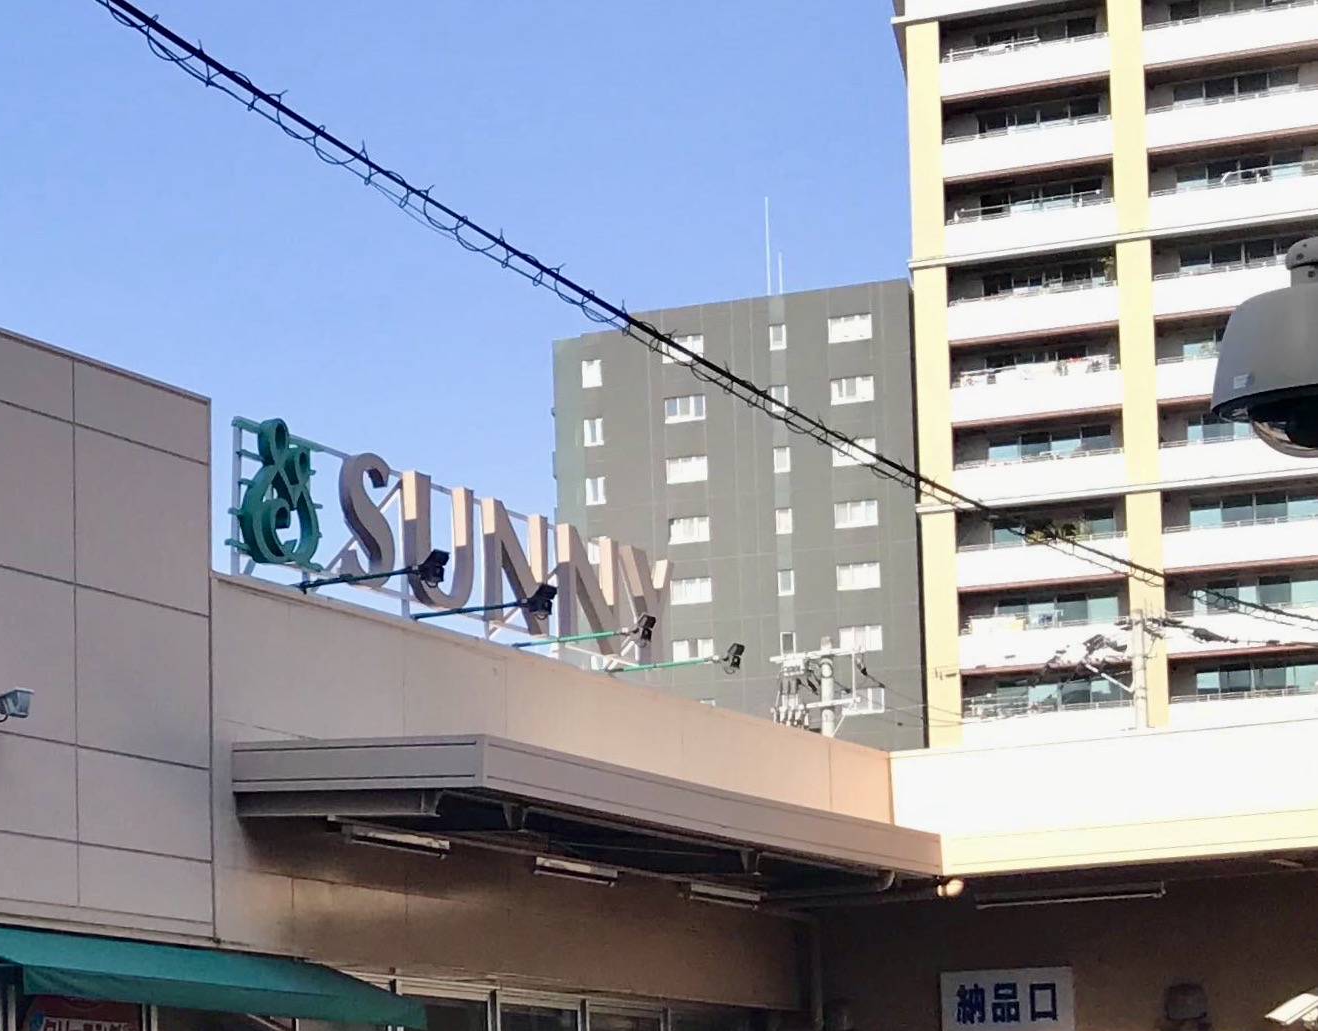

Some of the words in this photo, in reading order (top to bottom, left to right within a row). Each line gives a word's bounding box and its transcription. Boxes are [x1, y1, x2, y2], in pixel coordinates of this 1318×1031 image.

[338, 453, 673, 665] SUNNY
[956, 982, 1057, 1024] 納品口
